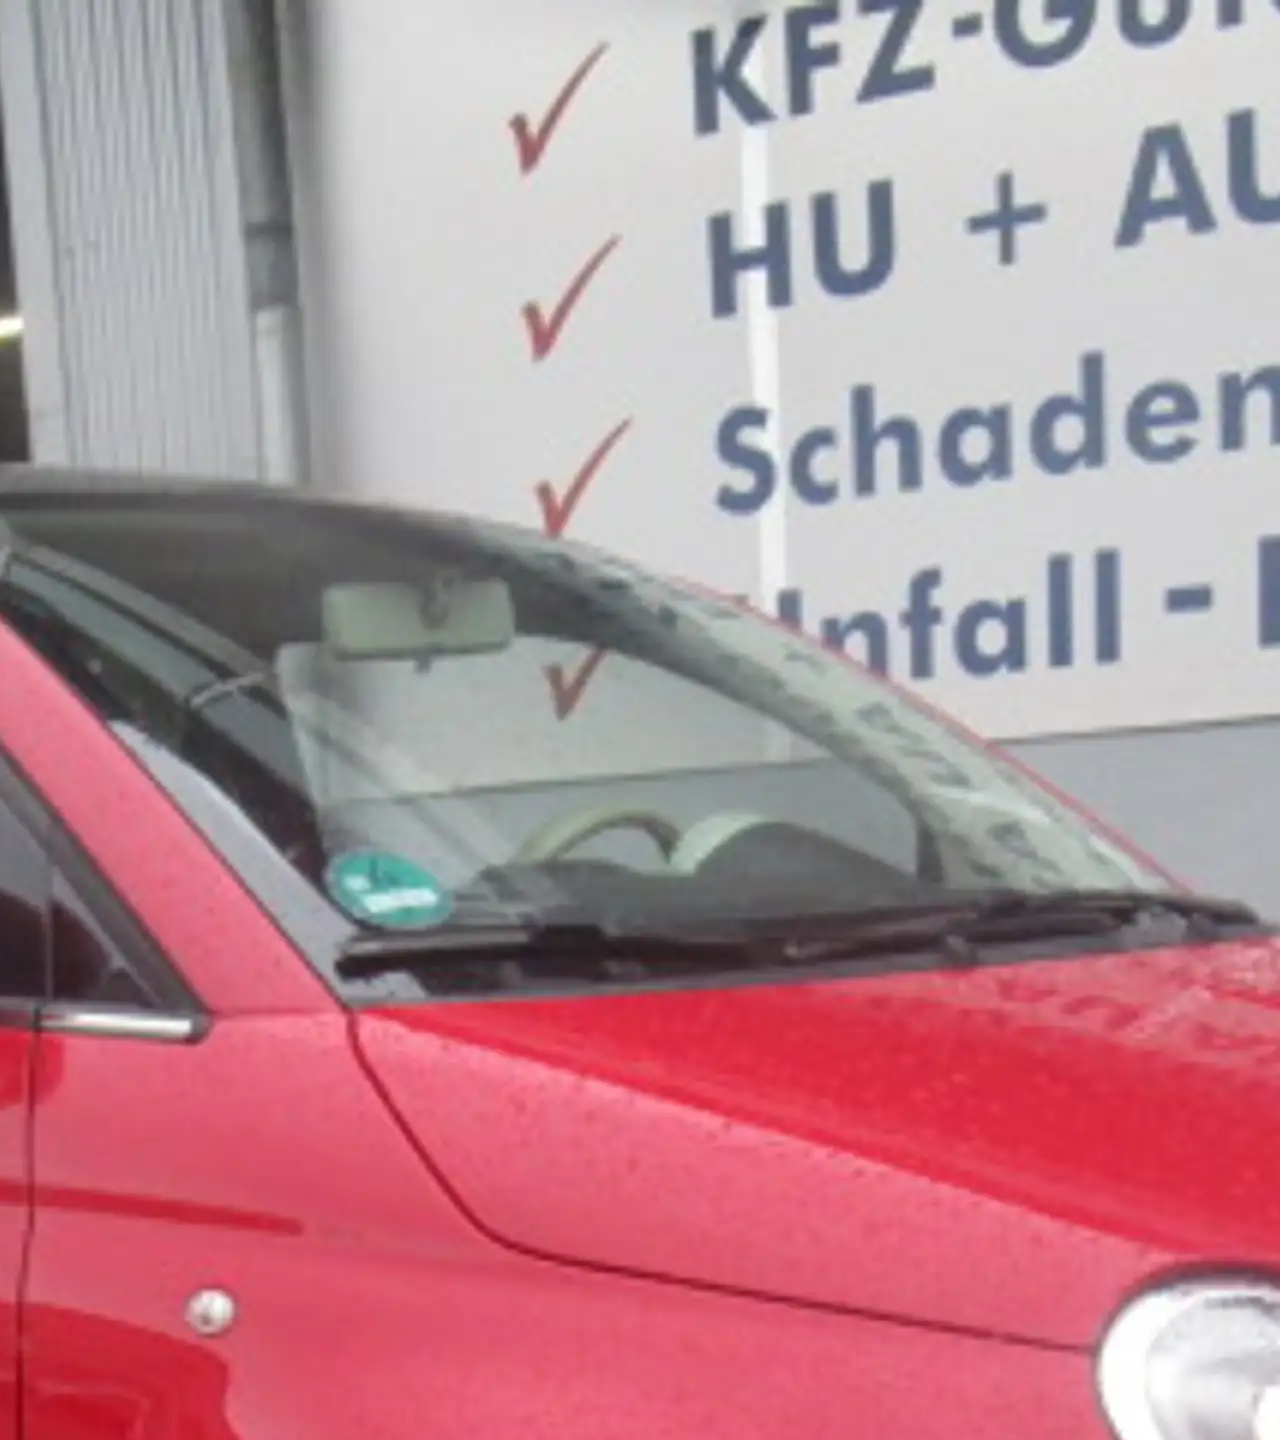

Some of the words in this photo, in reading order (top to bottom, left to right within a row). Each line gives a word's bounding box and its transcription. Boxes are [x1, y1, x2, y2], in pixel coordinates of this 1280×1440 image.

[705, 178, 896, 319] HU
[966, 171, 1048, 265] +
[732, 547, 1121, 680] nfall
